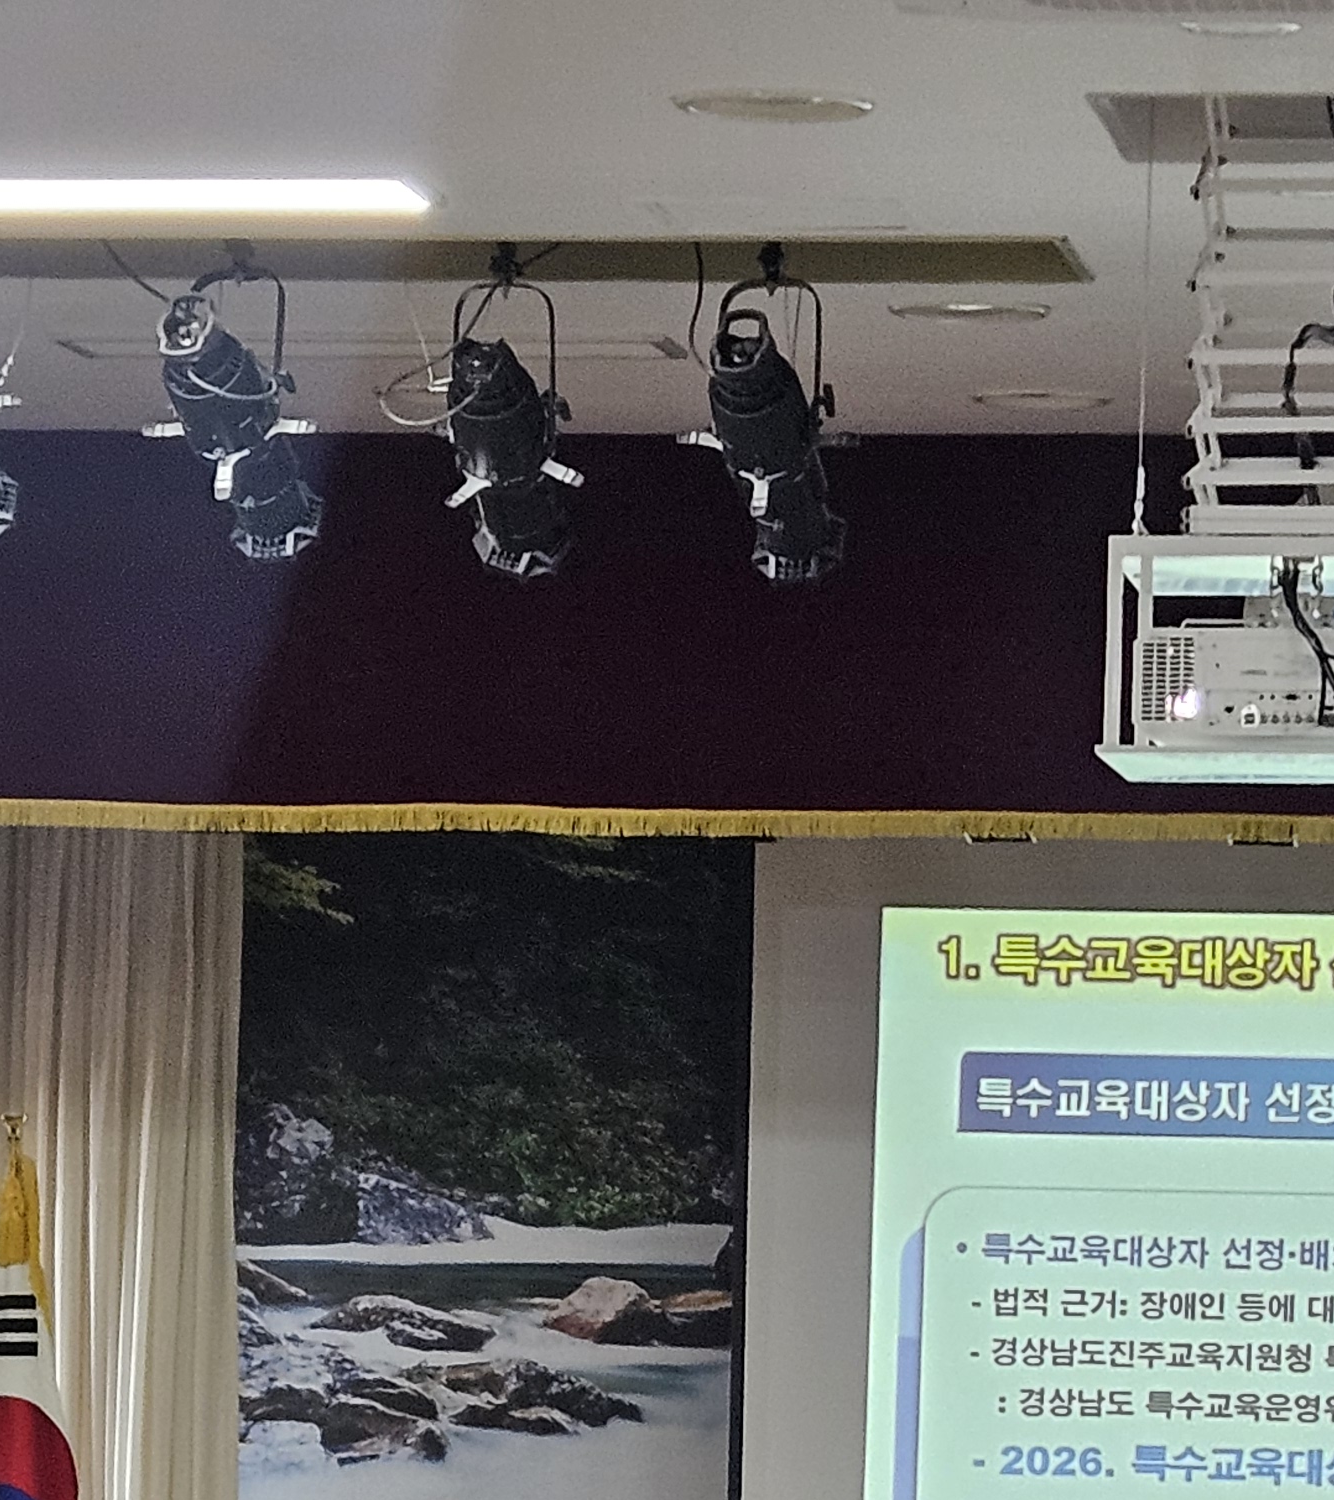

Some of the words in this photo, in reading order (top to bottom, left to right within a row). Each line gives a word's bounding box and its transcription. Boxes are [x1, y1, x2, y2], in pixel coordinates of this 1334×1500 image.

[938, 935, 980, 980] 1.
[991, 933, 1319, 991] 특수교육대상자
[977, 1077, 1250, 1122] 특수교육대상자
[981, 1232, 1210, 1270] 특수교육대상자
[993, 1287, 1049, 1317] 법적
[1060, 1289, 1128, 1319] 근거:
[1140, 1291, 1225, 1321] 장애인
[1236, 1293, 1296, 1323] 등에
[992, 1336, 1312, 1374] 경상남도진주교육지원청
[1019, 1387, 1135, 1418] 경상남도
[999, 1445, 1115, 1478] 2026.
